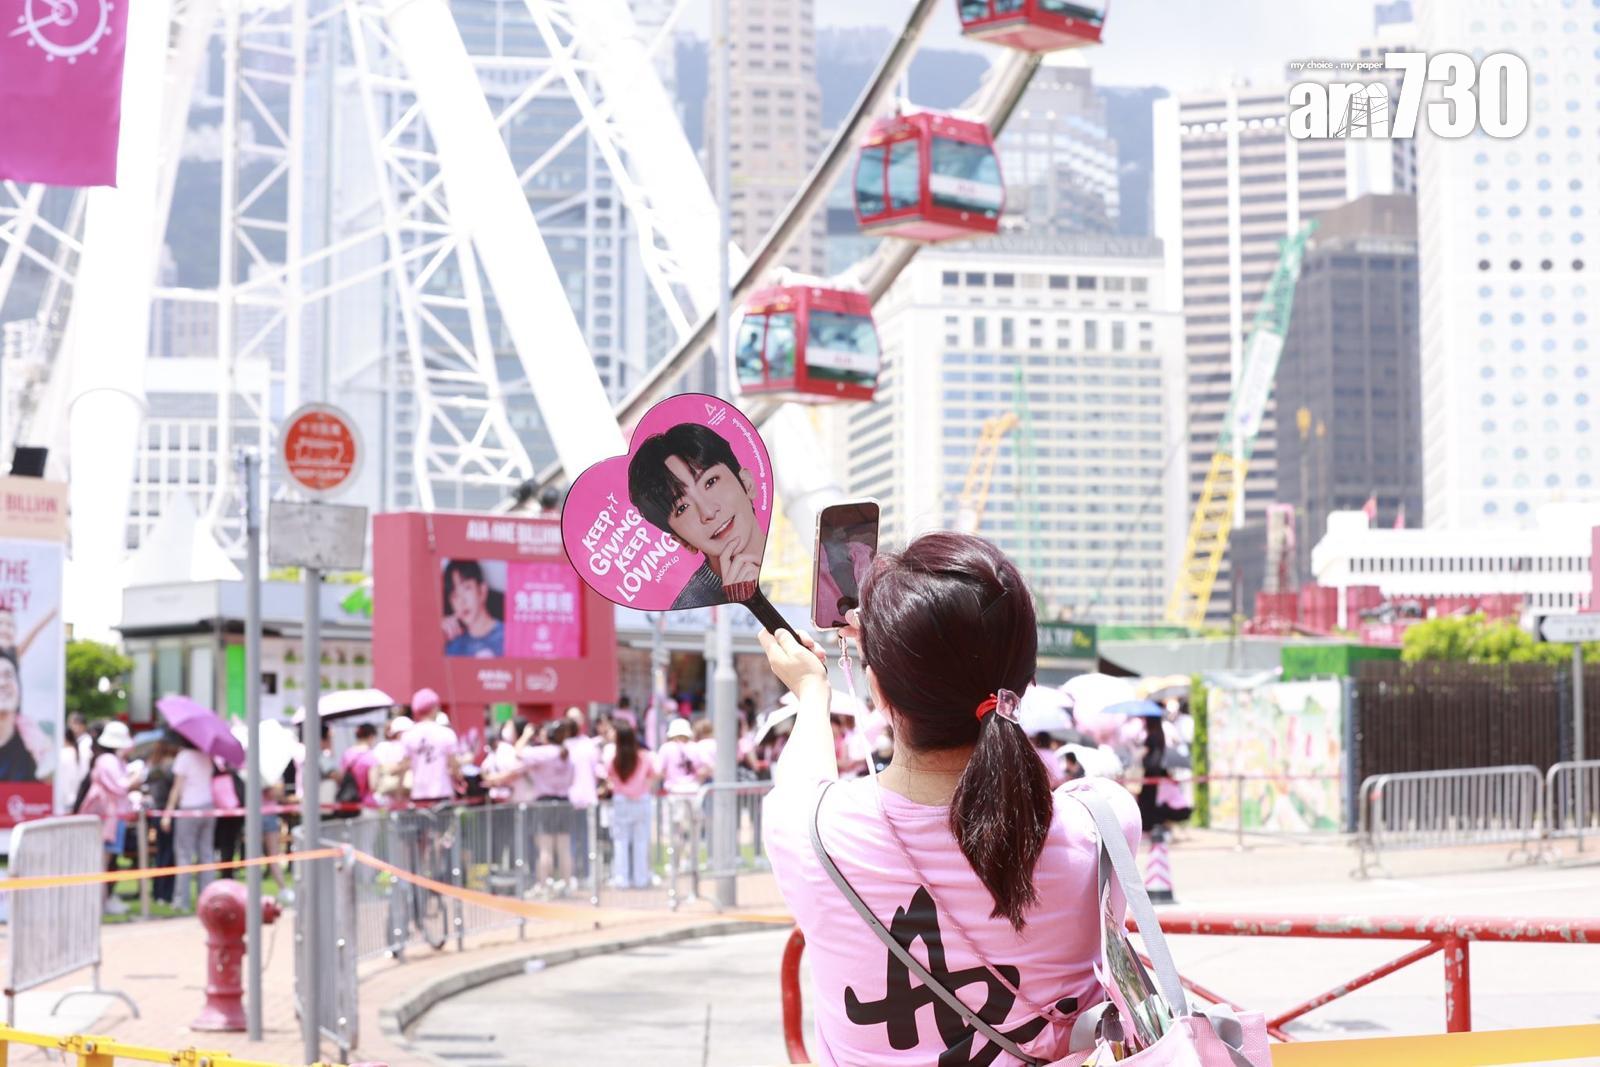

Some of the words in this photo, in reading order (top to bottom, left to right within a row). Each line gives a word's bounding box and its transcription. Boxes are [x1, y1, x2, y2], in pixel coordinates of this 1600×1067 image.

[582, 510, 615, 552] KEEP
[589, 509, 643, 576] GIVING
[614, 527, 652, 574] KEEP
[616, 532, 680, 602] LOVING
